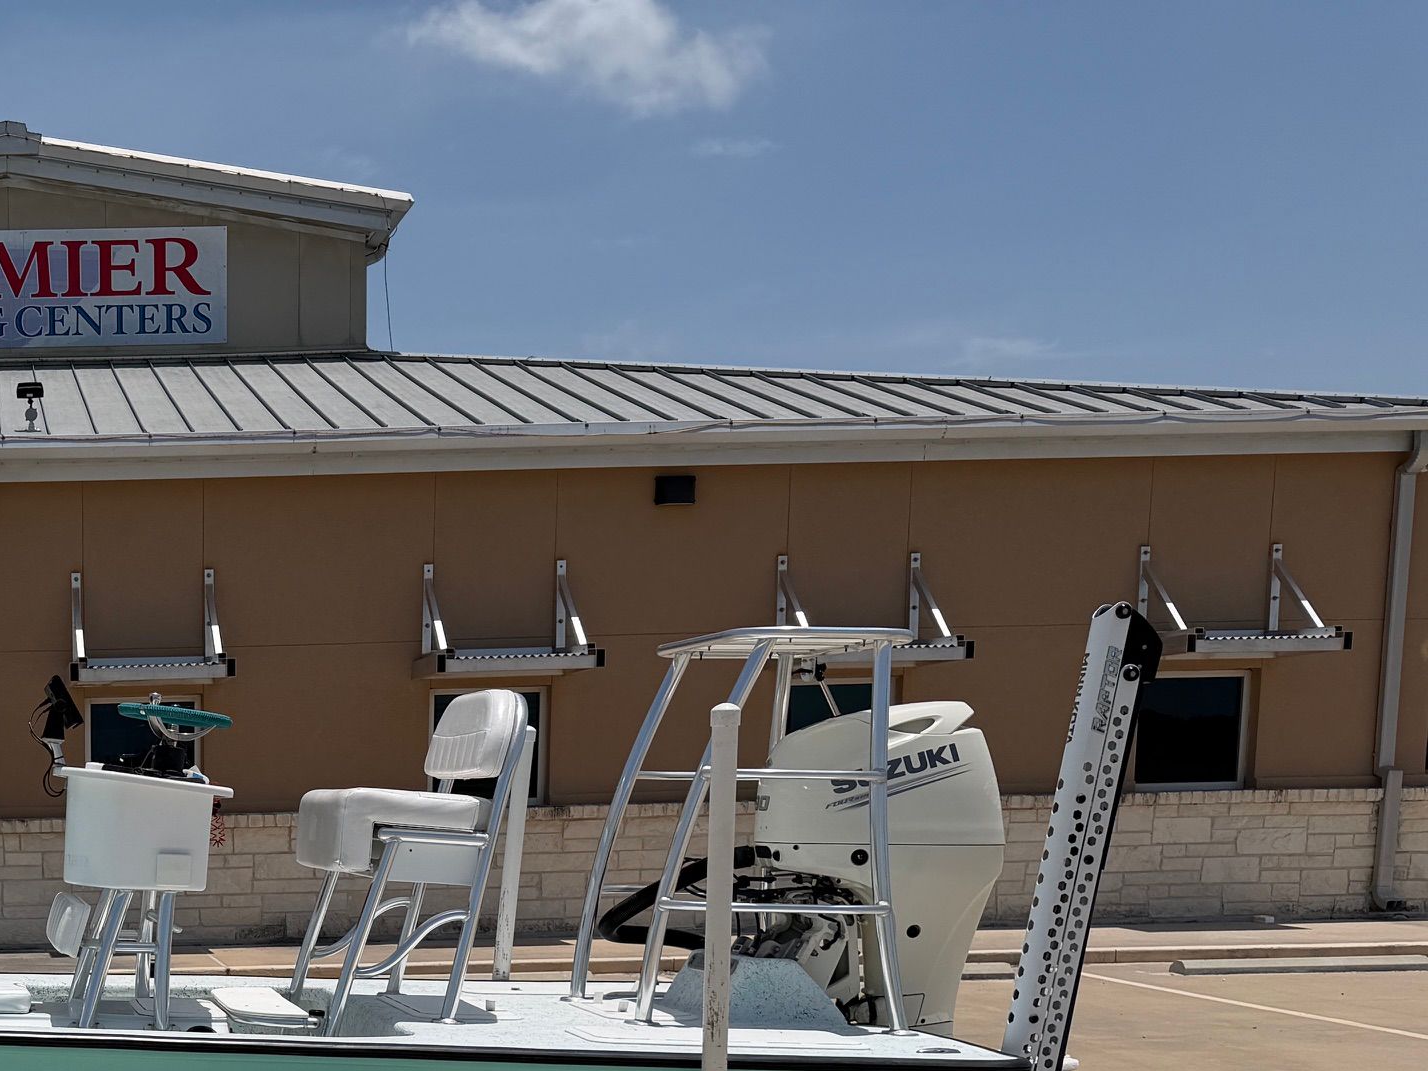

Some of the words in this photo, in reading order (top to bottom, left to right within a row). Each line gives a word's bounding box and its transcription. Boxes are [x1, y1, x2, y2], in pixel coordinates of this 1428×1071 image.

[15, 302, 212, 338] CENTERS
[1091, 645, 1123, 734] RAPTOR
[831, 742, 961, 794] SZUKI
